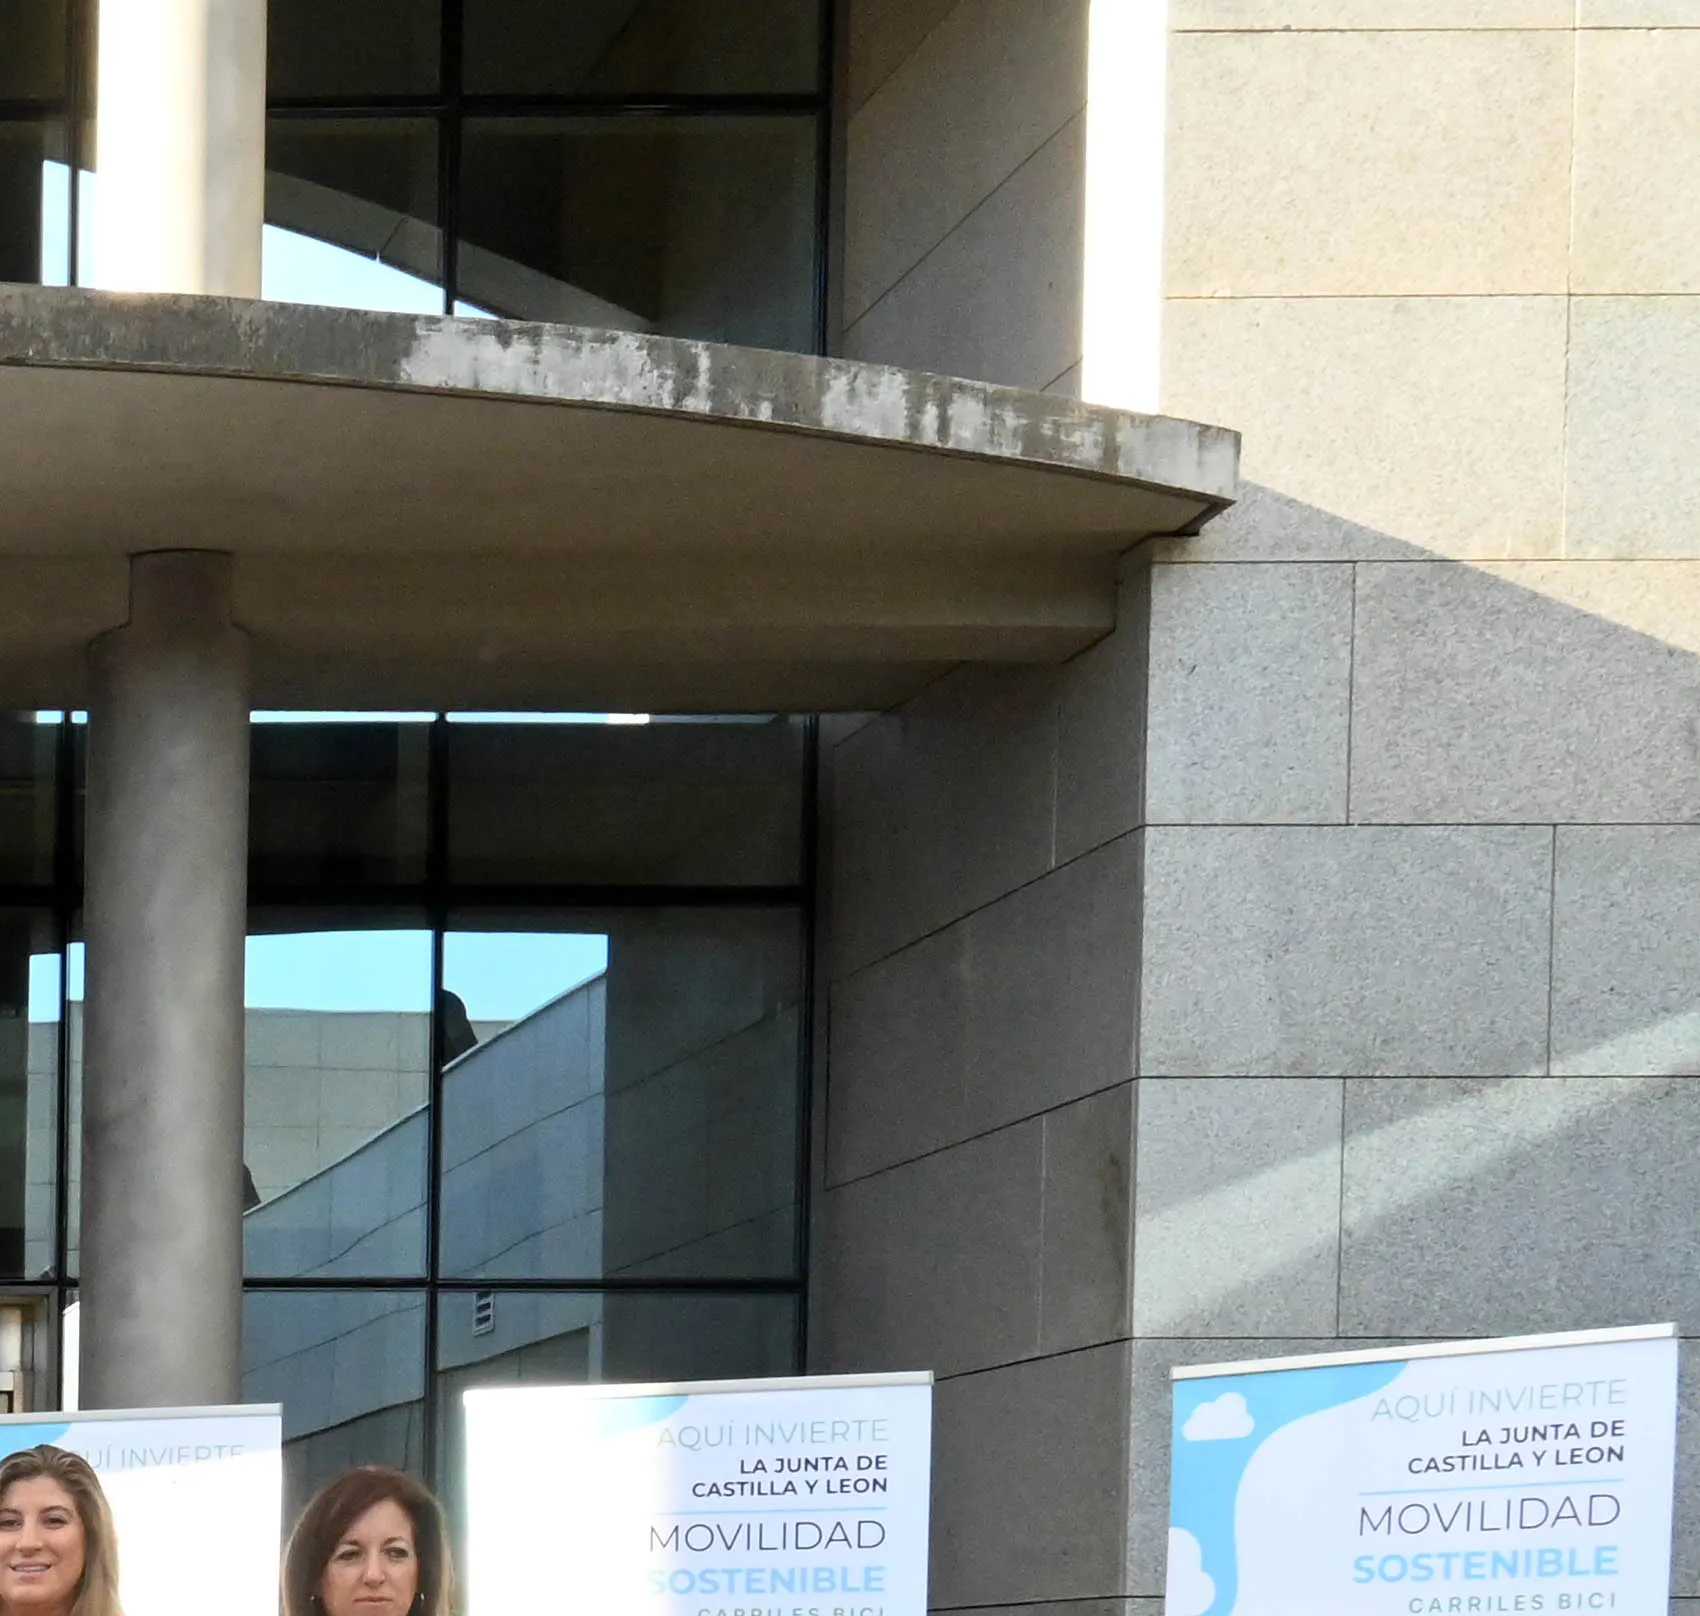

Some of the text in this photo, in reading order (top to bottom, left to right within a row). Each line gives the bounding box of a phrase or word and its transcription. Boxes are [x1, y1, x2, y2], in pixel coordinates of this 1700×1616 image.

[1371, 1378, 1627, 1425] AQUÍ INVIERTE
[657, 1418, 889, 1450] AQUÍ INVIERTE
[1461, 1419, 1625, 1447] LA JUNTA DE
[740, 1454, 888, 1475] LA JUNTA DE
[1407, 1445, 1625, 1475] CASTILLA Y LEON
[691, 1477, 888, 1498] CASTILLA Y LEON
[1359, 1493, 1621, 1537] MOVILIDAD
[650, 1519, 886, 1553] MOVILIDAD
[1353, 1545, 1619, 1585] SOSTENIBLE
[646, 1566, 886, 1595] SOSTENIBLE
[1408, 1591, 1616, 1615] CARRILES BICI
